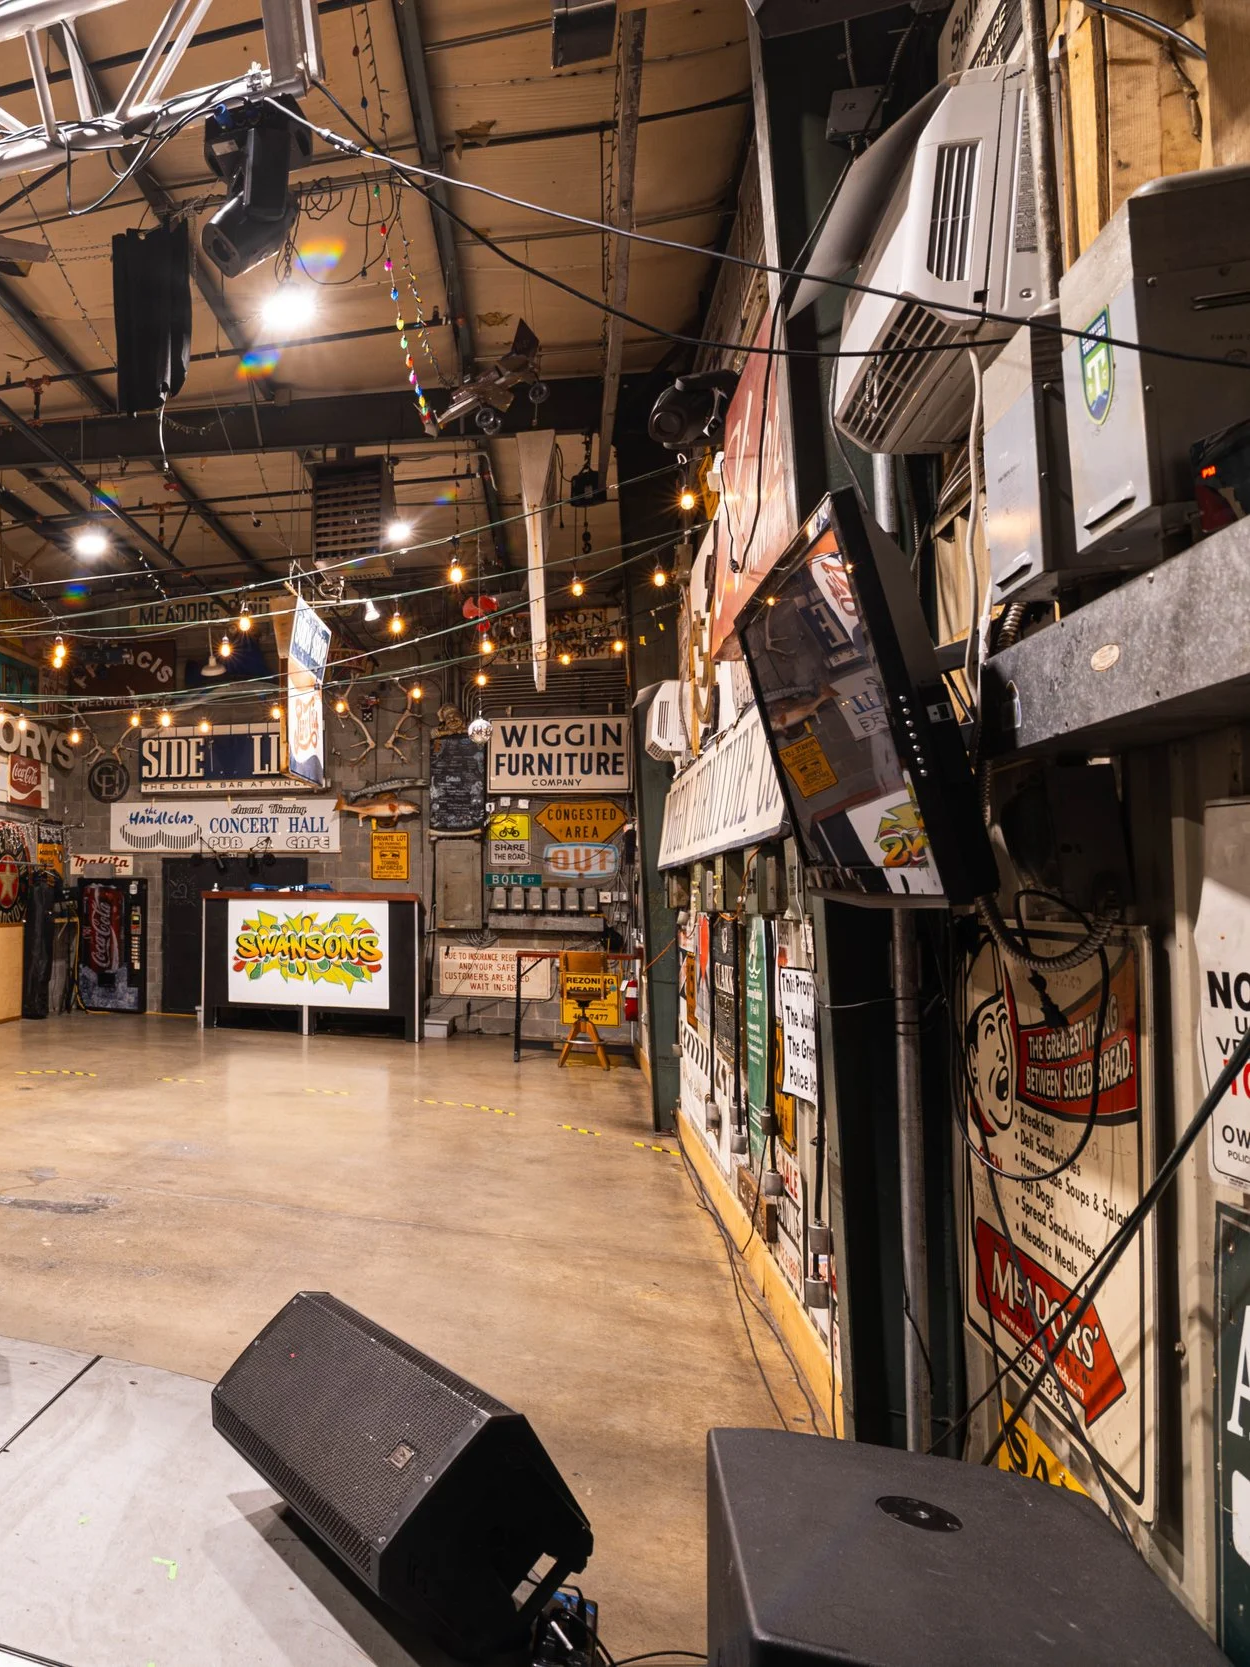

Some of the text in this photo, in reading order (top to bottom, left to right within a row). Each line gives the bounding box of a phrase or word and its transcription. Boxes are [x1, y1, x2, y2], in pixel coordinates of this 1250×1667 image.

[1202, 466, 1216, 478] PM
[139, 601, 221, 625] MEADORS
[500, 722, 623, 749] WIGGIN
[141, 737, 205, 779] SIDE
[494, 752, 625, 777] FURNITURE
[531, 778, 582, 787] COMPANY
[129, 811, 194, 825] Handlebar
[145, 807, 157, 815] the
[231, 803, 308, 815] Award Winning
[547, 808, 617, 821] CONGESTED
[209, 816, 329, 833] CONCERT HALL
[565, 826, 599, 838] AREA
[208, 836, 243, 849] PUB
[286, 836, 330, 849] CAFE
[551, 848, 613, 872] OUT
[492, 875, 524, 885] BOLT
[235, 932, 384, 962] SWANSONS
[458, 952, 467, 960] TO
[468, 953, 498, 961] INSURANCE
[444, 972, 530, 983] CUSTOMERS ARE ASED
[474, 963, 493, 971] YOUR
[496, 963, 527, 972] SAFEY
[469, 982, 489, 990] WAIT
[782, 971, 796, 992] This
[785, 1005, 799, 1026] The
[787, 1035, 800, 1055] The
[1027, 1021, 1085, 1062] THE GREATEST
[789, 1066, 809, 1090] Police
[1025, 1036, 1134, 1099] BETWEEN SLICED BREAD.
[1019, 1107, 1055, 1139] Breakfast
[1020, 1130, 1081, 1177] Deli Sandwiches
[1021, 1174, 1055, 1209] Hot Dogs
[1065, 1177, 1100, 1212] Soups &
[1021, 1194, 1097, 1263] Spread Sandwiches
[1021, 1220, 1079, 1278] Meadors Meals
